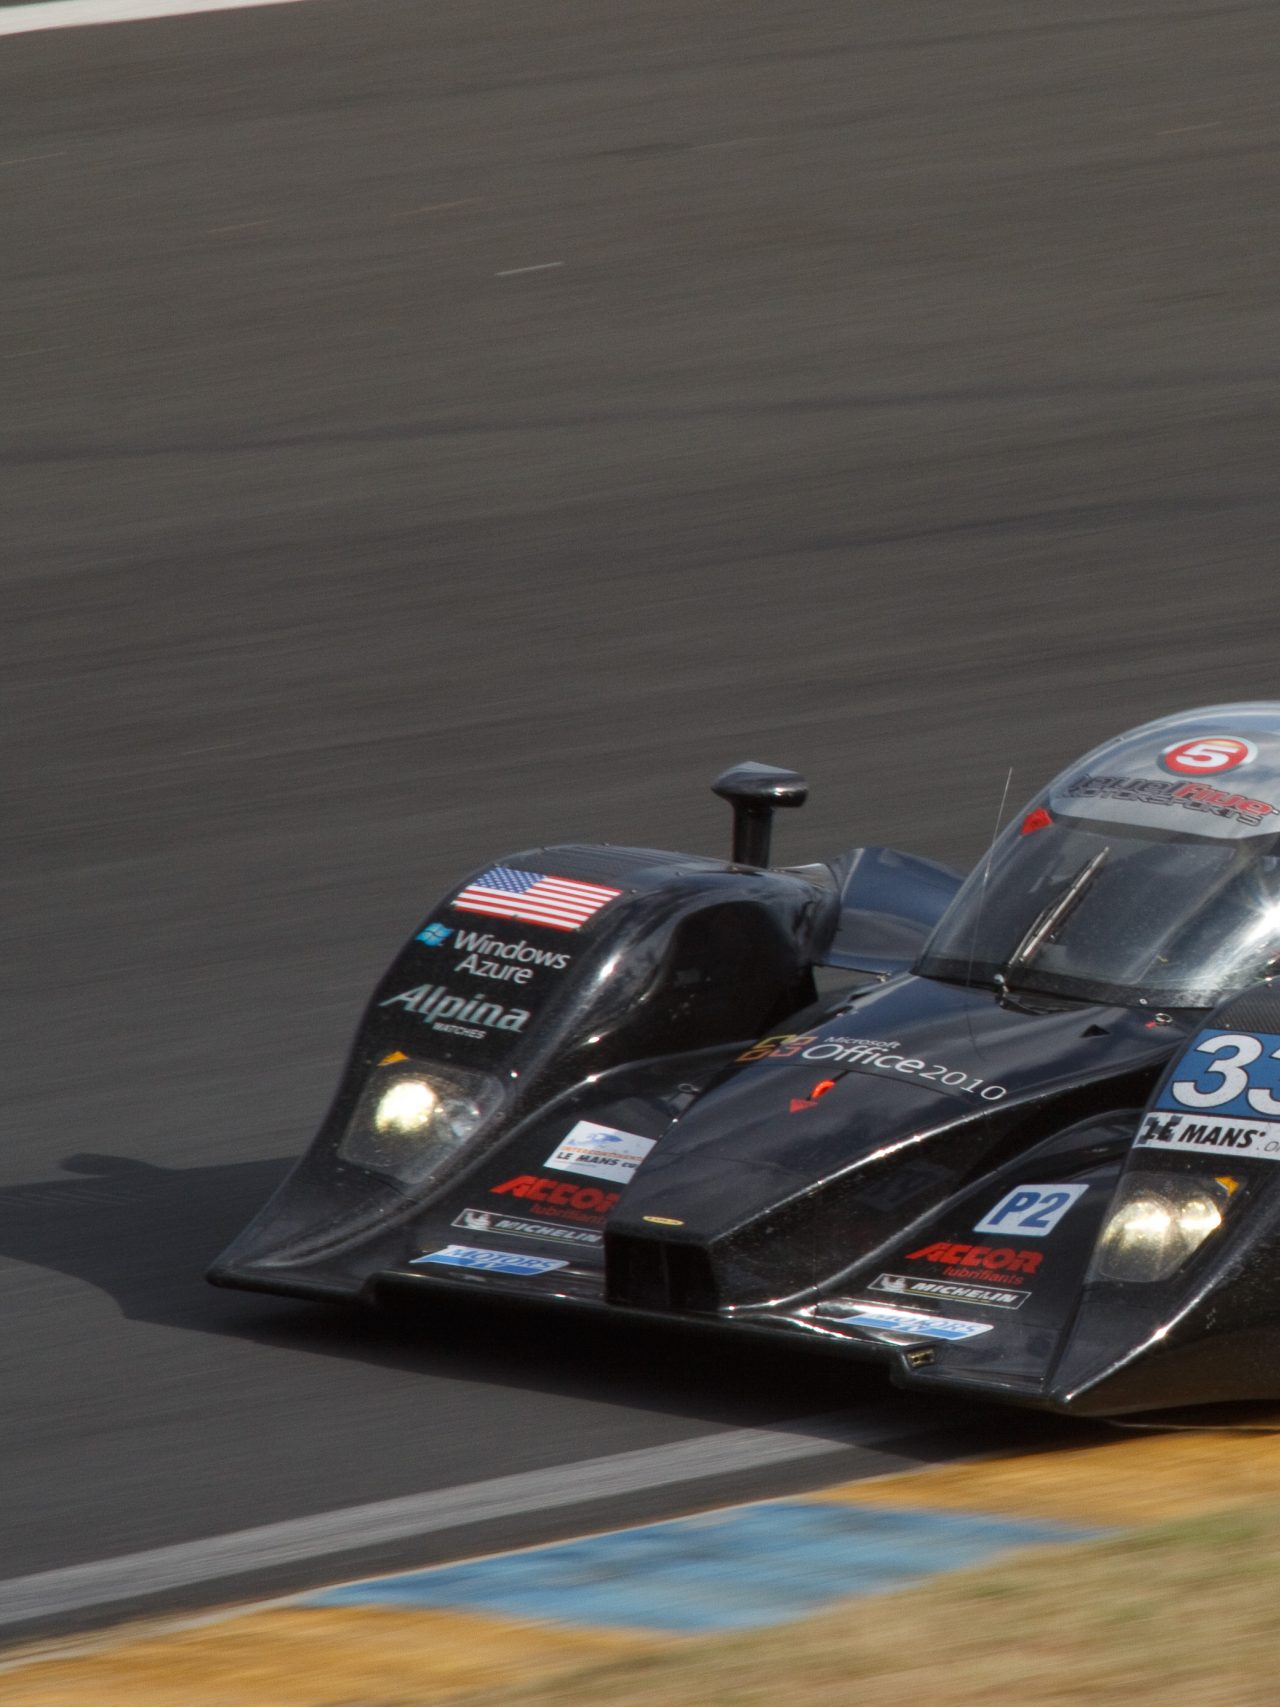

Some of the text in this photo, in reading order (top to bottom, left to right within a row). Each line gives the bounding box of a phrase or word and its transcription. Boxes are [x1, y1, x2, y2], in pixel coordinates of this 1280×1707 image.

[1176, 743, 1241, 768] 5
[453, 929, 571, 970] Windows
[454, 953, 534, 985] Azure
[379, 983, 531, 1033] Alpina
[432, 1022, 487, 1040] WATCHES
[823, 1036, 902, 1049] Microsoft
[801, 1043, 1008, 1101] Office 2010
[557, 1152, 573, 1161] LE
[576, 1154, 619, 1166] MANS
[987, 1191, 1071, 1229] P2
[496, 1219, 603, 1243] MICHELIN
[449, 1247, 556, 1270] MOTORS
[904, 1241, 1044, 1274] ACCOR
[943, 1266, 1025, 1286] lubrifiants
[910, 1282, 1019, 1303] MICHELIN
